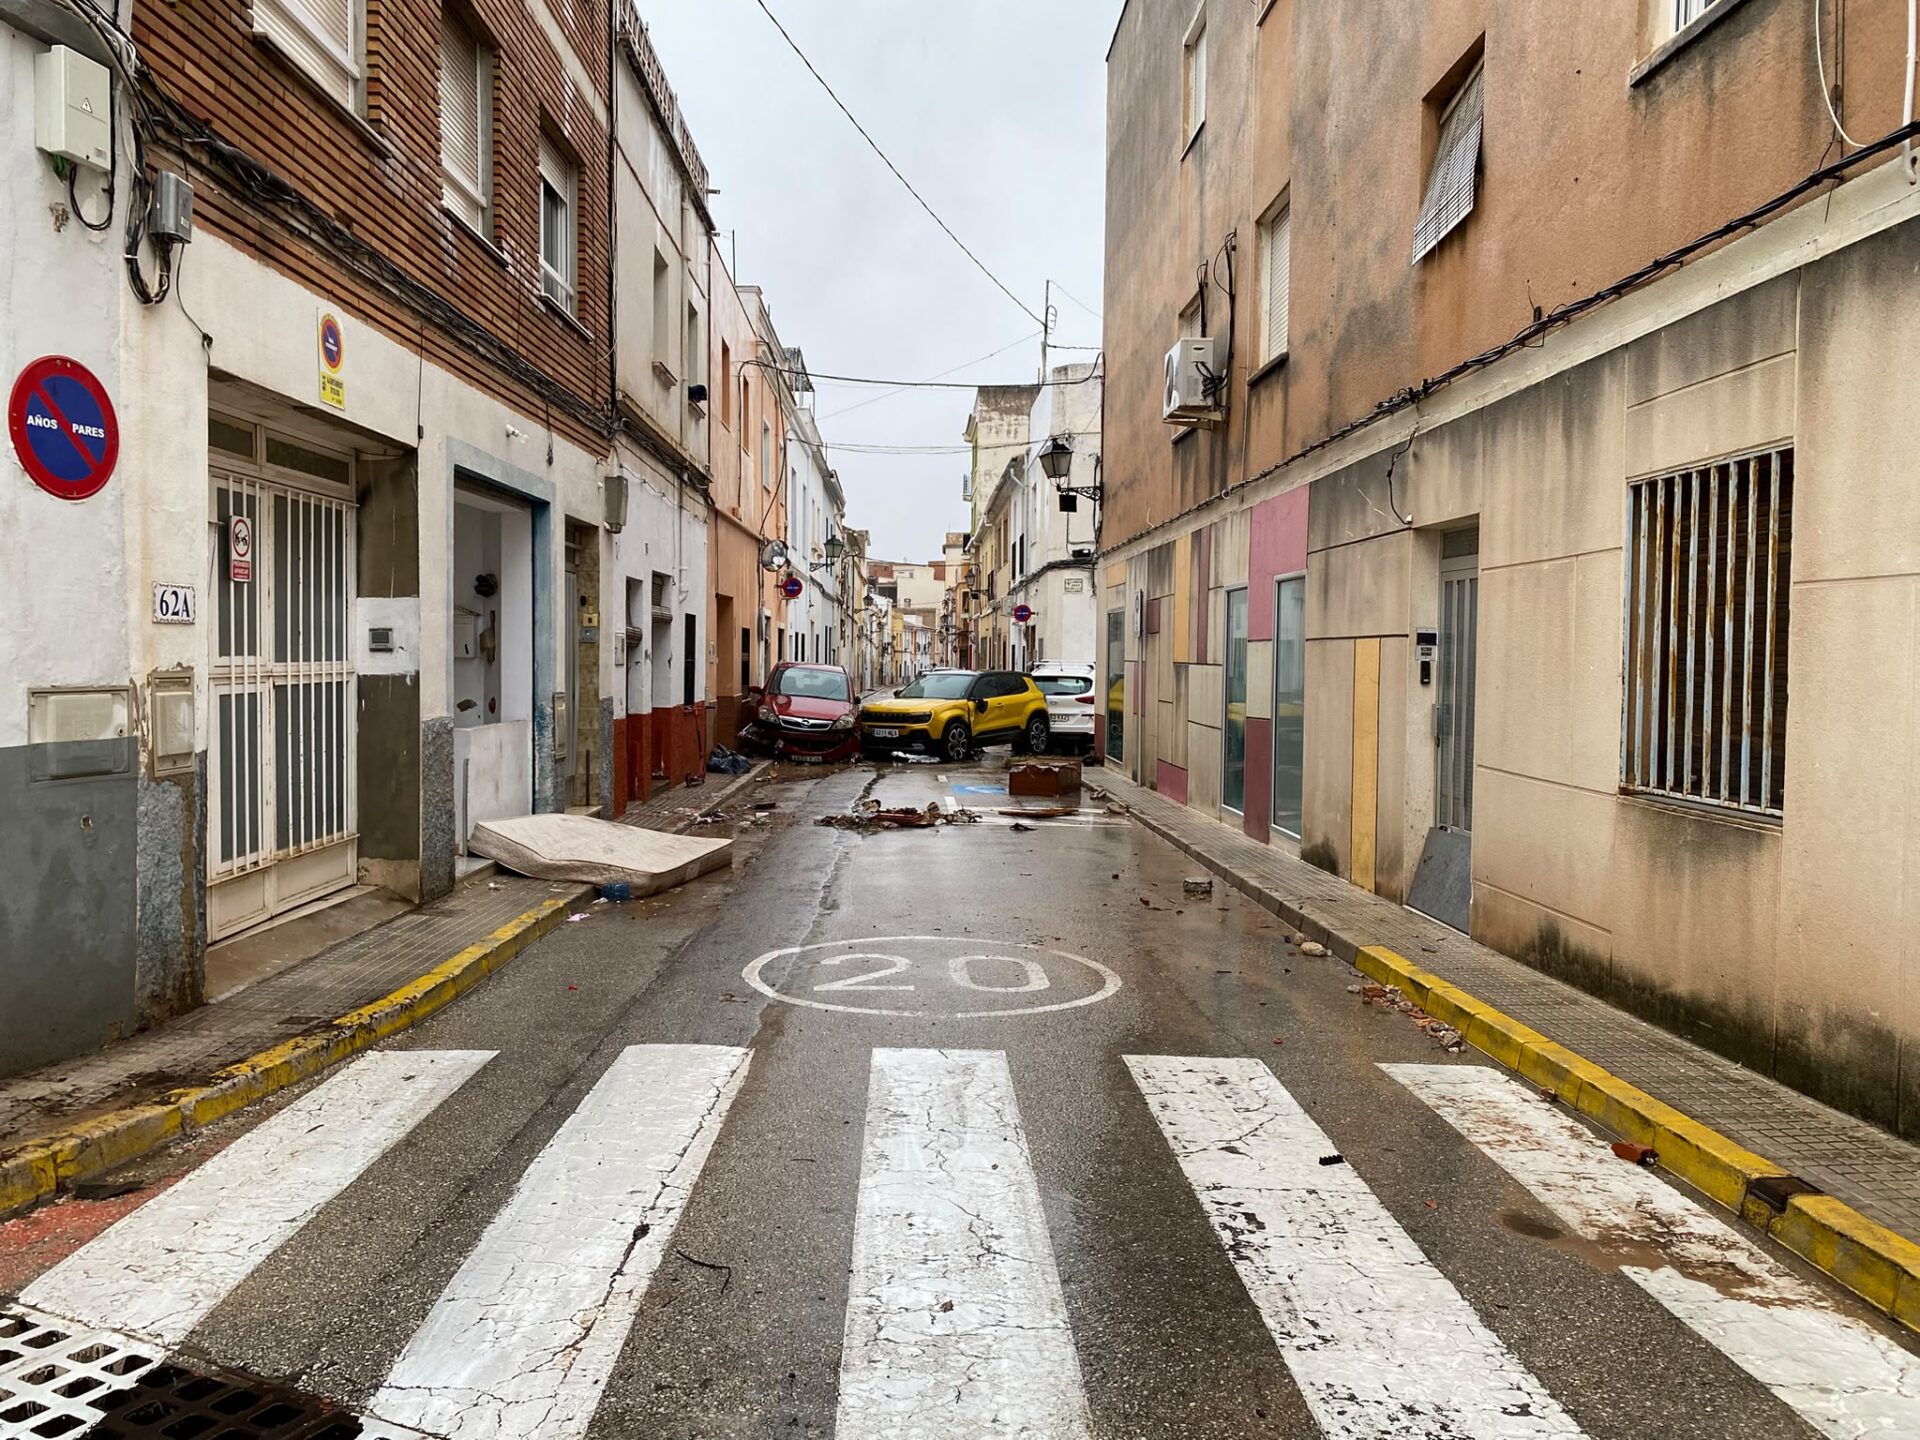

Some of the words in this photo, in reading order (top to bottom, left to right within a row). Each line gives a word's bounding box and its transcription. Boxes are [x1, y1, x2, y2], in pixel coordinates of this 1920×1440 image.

[26, 414, 58, 430] AÑOS
[72, 423, 105, 439] PARES
[159, 589, 190, 618] 62A
[813, 953, 1051, 993] 20
